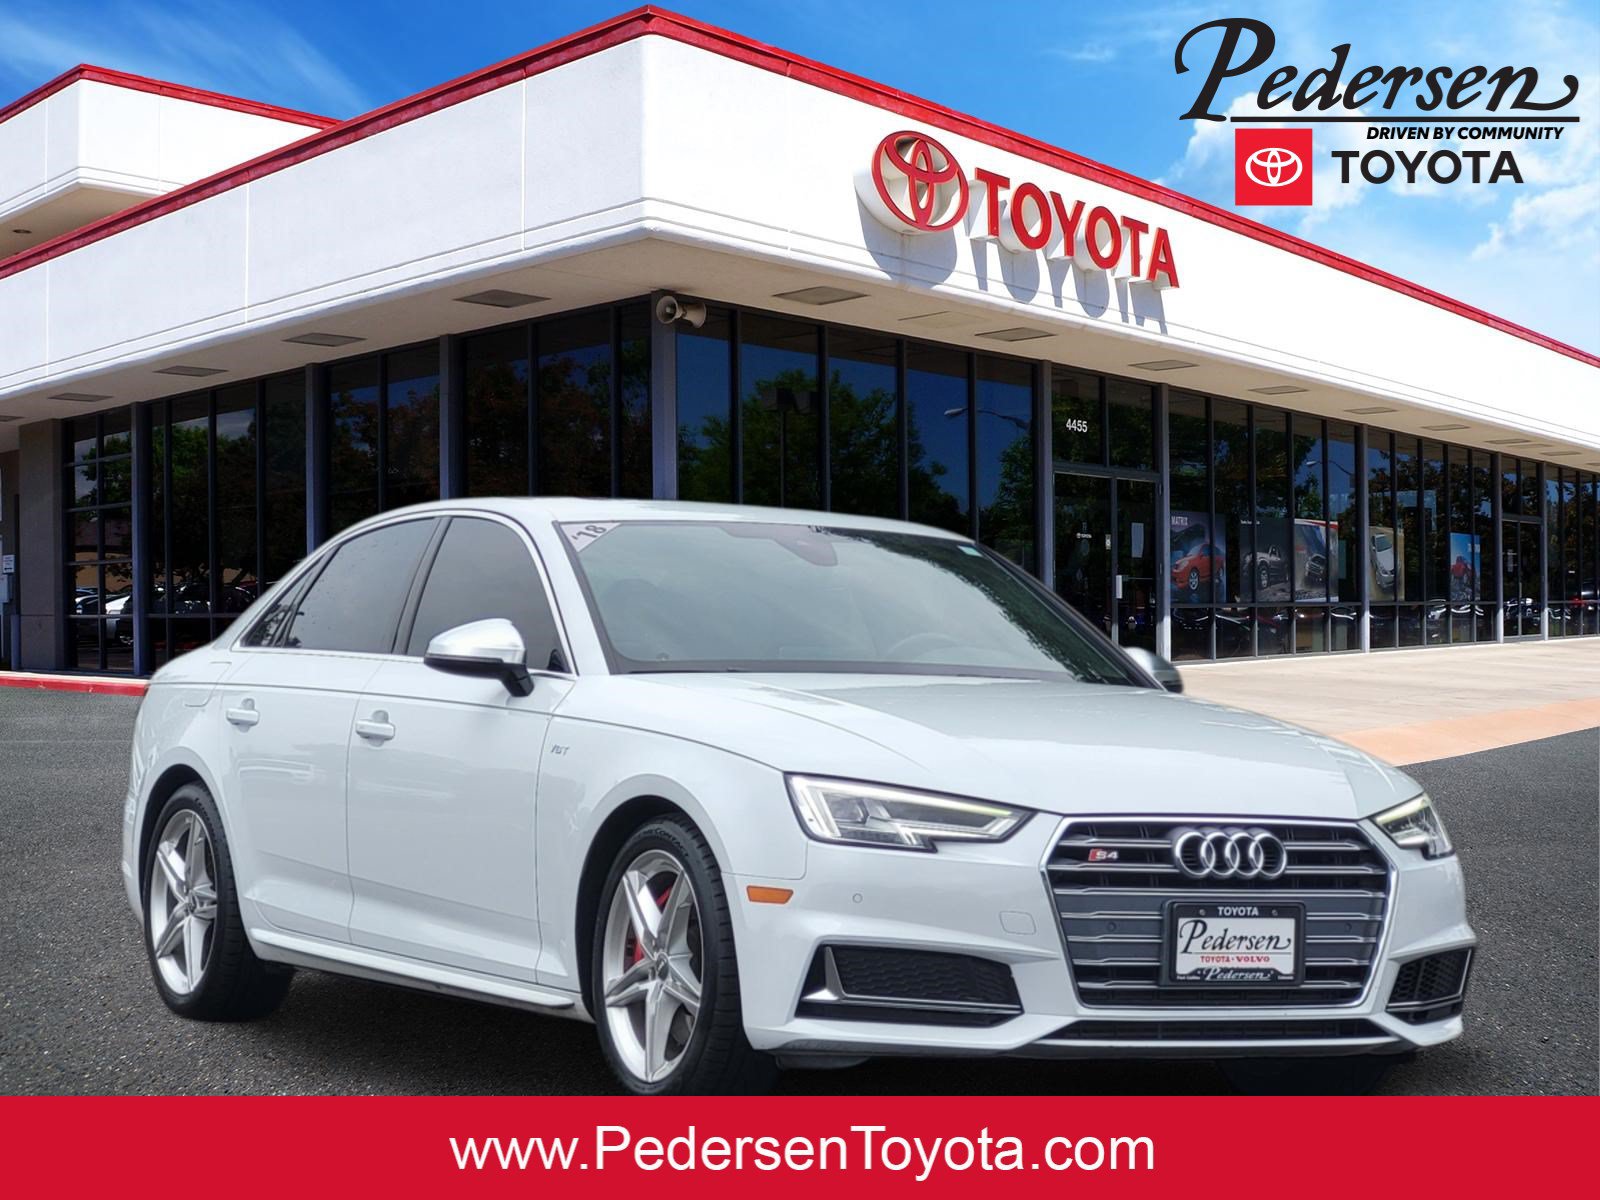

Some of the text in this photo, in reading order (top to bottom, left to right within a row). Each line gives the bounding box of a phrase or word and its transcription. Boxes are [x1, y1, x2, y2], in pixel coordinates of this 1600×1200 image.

[974, 167, 1180, 288] TOYOTA
[1066, 418, 1088, 432] 4455
[1093, 850, 1118, 860] S4
[1217, 906, 1259, 916] TOYOTA
[1179, 919, 1291, 954] Pedersen
[1236, 955, 1270, 963] VOLVO
[1203, 967, 1271, 981] Pedersen
